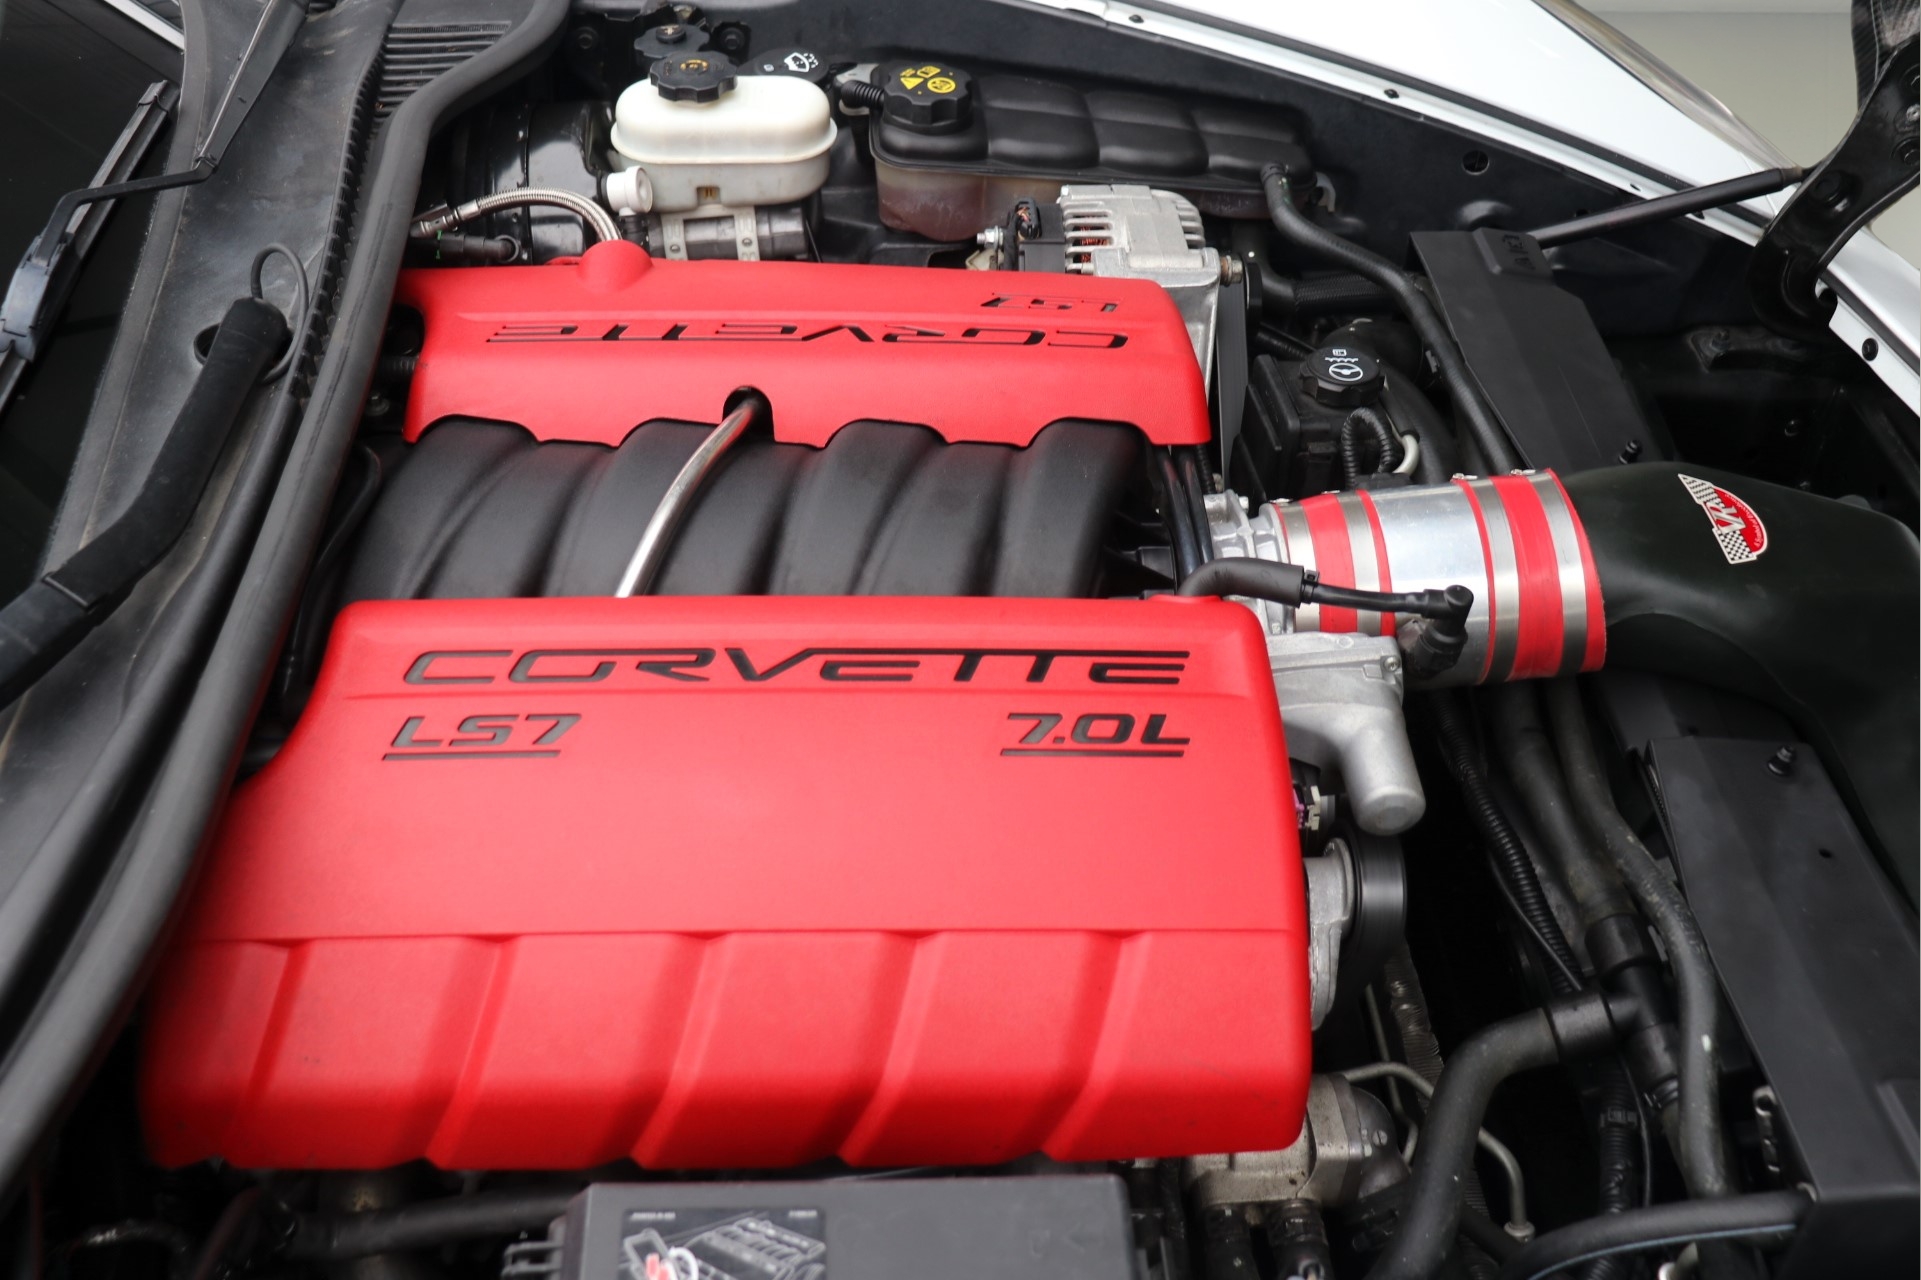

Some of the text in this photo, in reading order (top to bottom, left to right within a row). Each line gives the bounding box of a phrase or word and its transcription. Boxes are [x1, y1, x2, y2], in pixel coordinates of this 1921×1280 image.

[980, 296, 1119, 313] LS7
[486, 323, 1129, 349] CORVETTE
[403, 647, 1190, 685] CORVETTE
[390, 713, 581, 748] LS7
[1007, 712, 1190, 745] 7.0L
